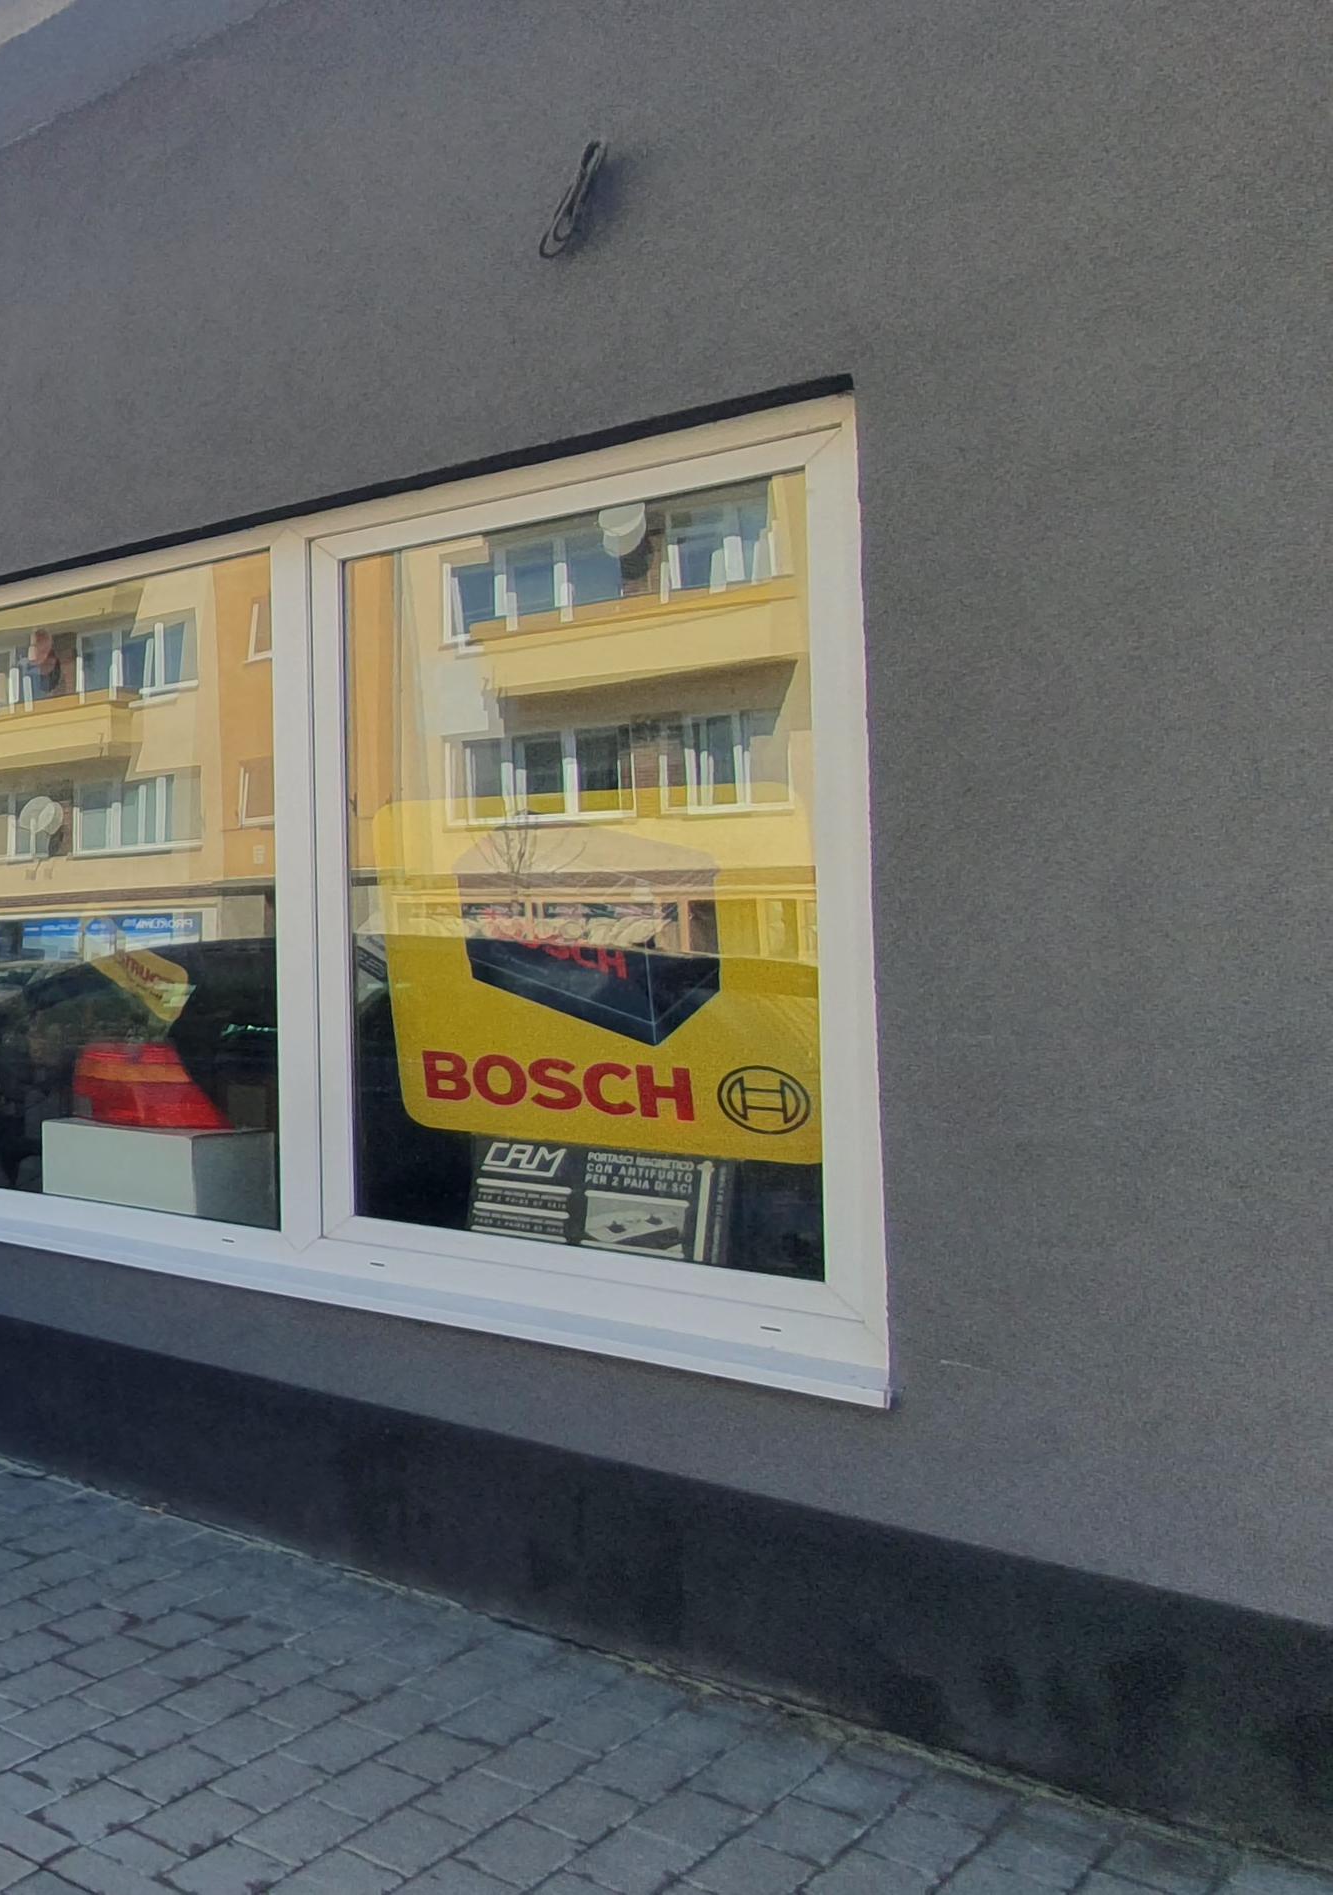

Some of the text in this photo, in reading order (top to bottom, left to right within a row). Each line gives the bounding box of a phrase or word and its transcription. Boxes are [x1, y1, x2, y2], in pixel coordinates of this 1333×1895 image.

[422, 1050, 696, 1121] BOSCH
[480, 1141, 568, 1177] CAM
[585, 1162, 694, 1183] CON ANTIFURTO
[584, 1173, 607, 1184] PER
[611, 1176, 620, 1187] 2
[623, 1178, 650, 1190] PAIA
